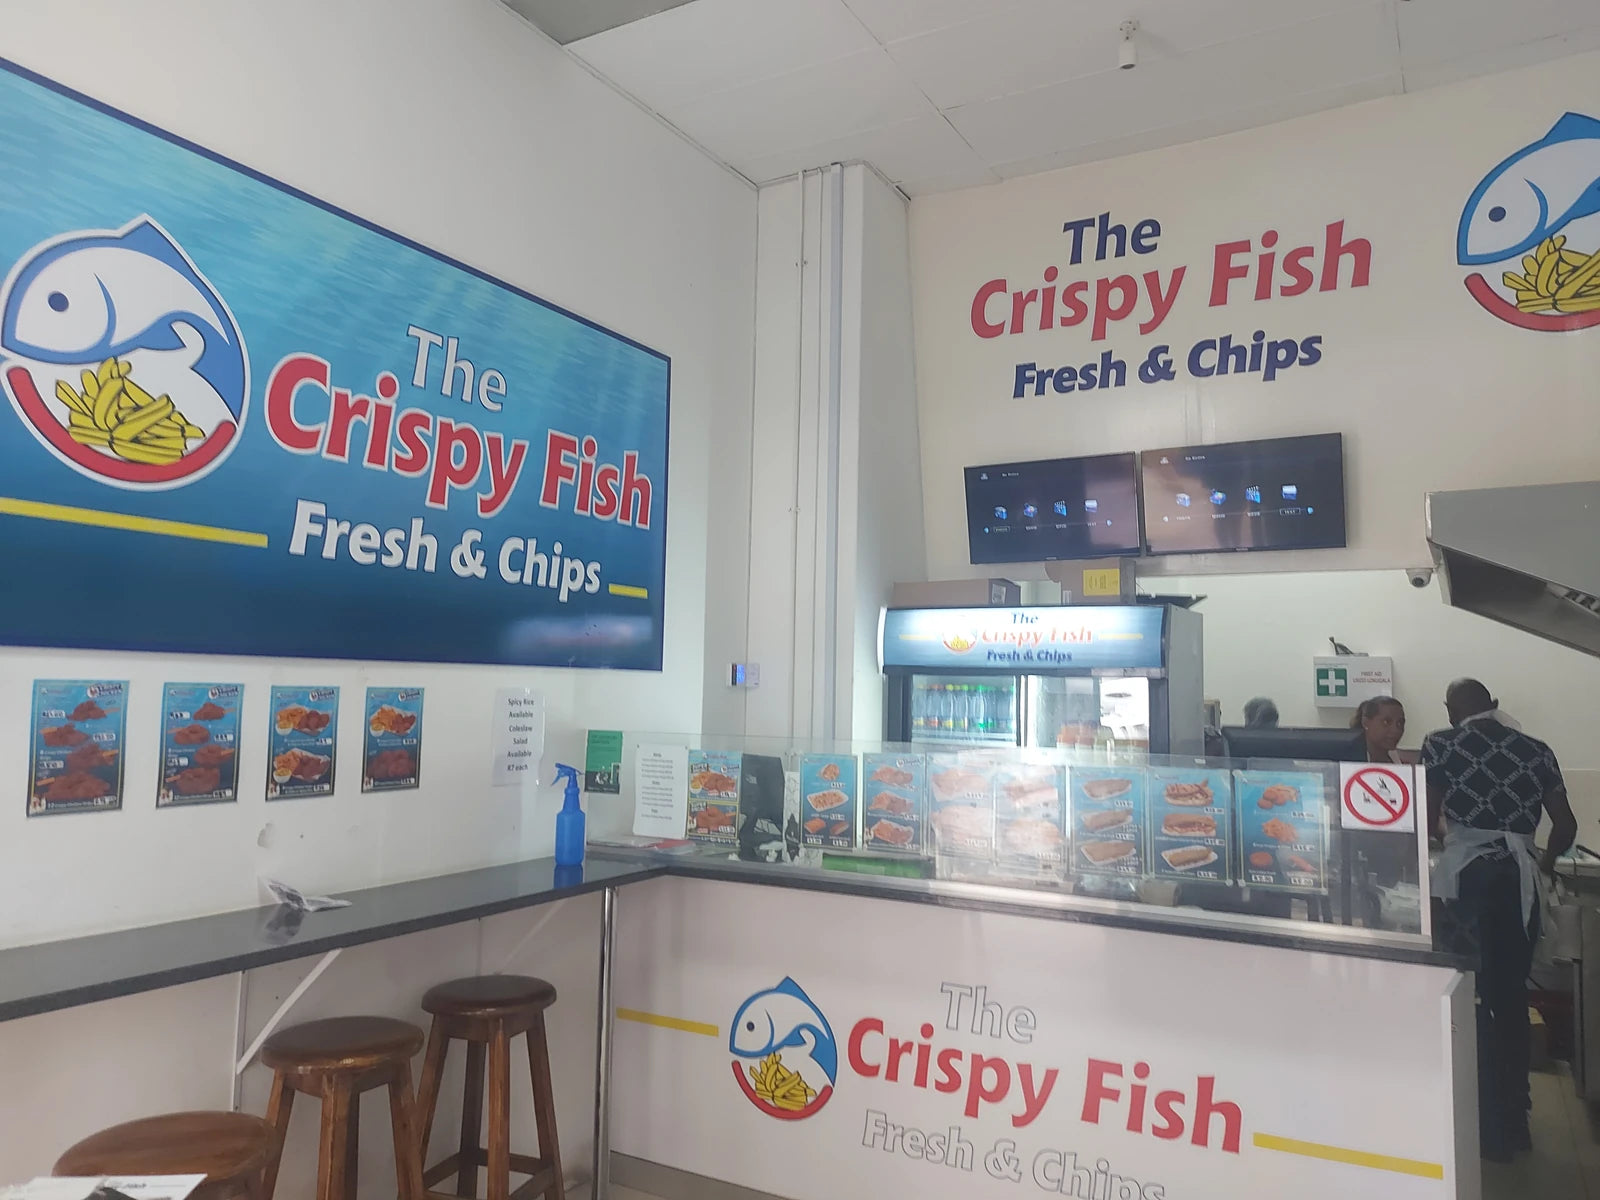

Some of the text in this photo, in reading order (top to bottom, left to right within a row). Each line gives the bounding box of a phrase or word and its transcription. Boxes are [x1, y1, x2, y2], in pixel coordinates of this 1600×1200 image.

[1062, 211, 1161, 265] The
[970, 219, 1372, 341] Crispy Fish
[407, 324, 507, 413] The
[1012, 330, 1322, 399] Fresh & Chips
[265, 352, 653, 530] Crispy Fish
[289, 498, 600, 602] Fresh & Chips
[982, 625, 1093, 648] Crispy Fish
[1011, 612, 1039, 625] The
[987, 649, 1072, 663] Fresh & Chips
[508, 698, 535, 707] Spicy Rice
[508, 725, 533, 733] Coleslaw
[507, 750, 532, 758] Available
[513, 737, 528, 745] Salad
[515, 764, 528, 772] each
[940, 982, 1037, 1044] The
[847, 1016, 1242, 1154] Crispy Fish
[862, 1108, 1165, 1200] Fresh & Chips
